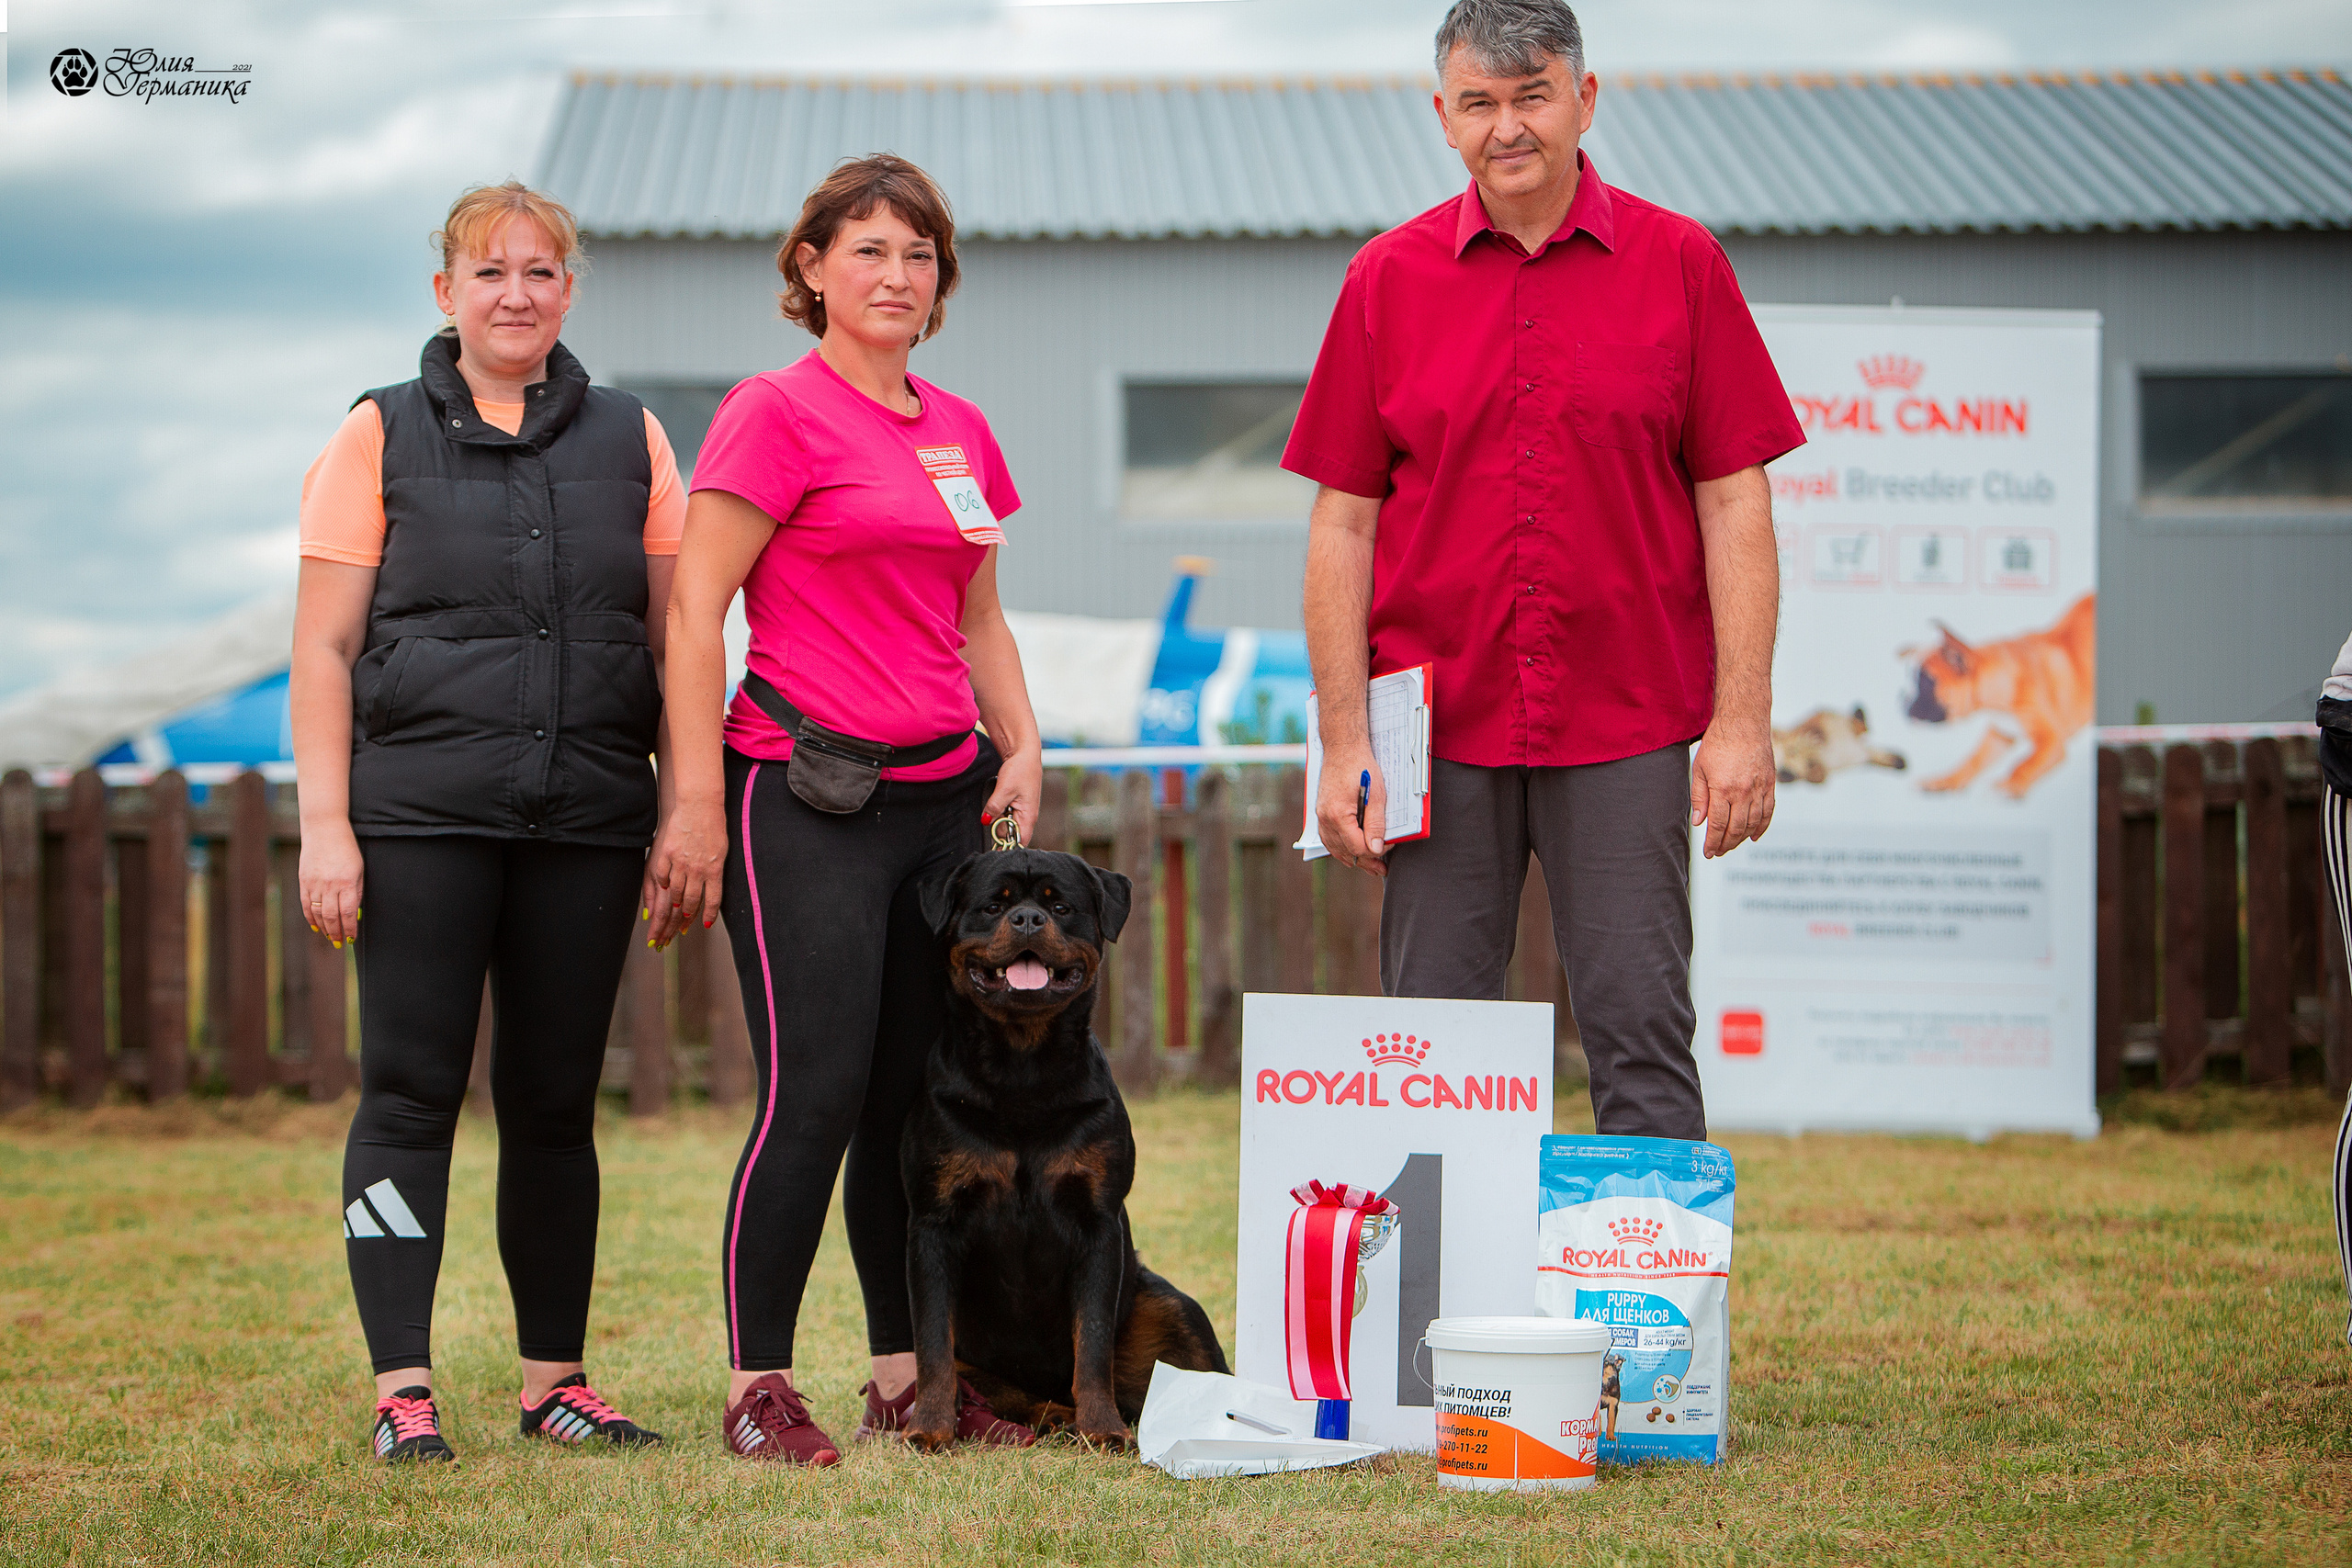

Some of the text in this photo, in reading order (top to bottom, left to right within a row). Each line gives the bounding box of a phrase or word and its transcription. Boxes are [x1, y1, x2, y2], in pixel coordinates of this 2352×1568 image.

[1791, 396, 2029, 437] OYAL CANIN
[1766, 467, 2055, 505] oyal Breeder Club
[1256, 1068, 1538, 1111] ROYAL CANIN
[1690, 1159, 1698, 1173] 3
[1562, 1247, 1708, 1269] ROYAL CANIN
[1376, 1153, 1442, 1406] 1
[1607, 1292, 1646, 1308] PUPPY
[1580, 1308, 1670, 1325] ДЛЯ ЩЕНКОВ
[1612, 1328, 1634, 1337] СОБАК
[1434, 1383, 1511, 1404] ЬНЫЙ ПОДХОД
[1443, 1403, 1511, 1420] ПИТОМЦЕВ!
